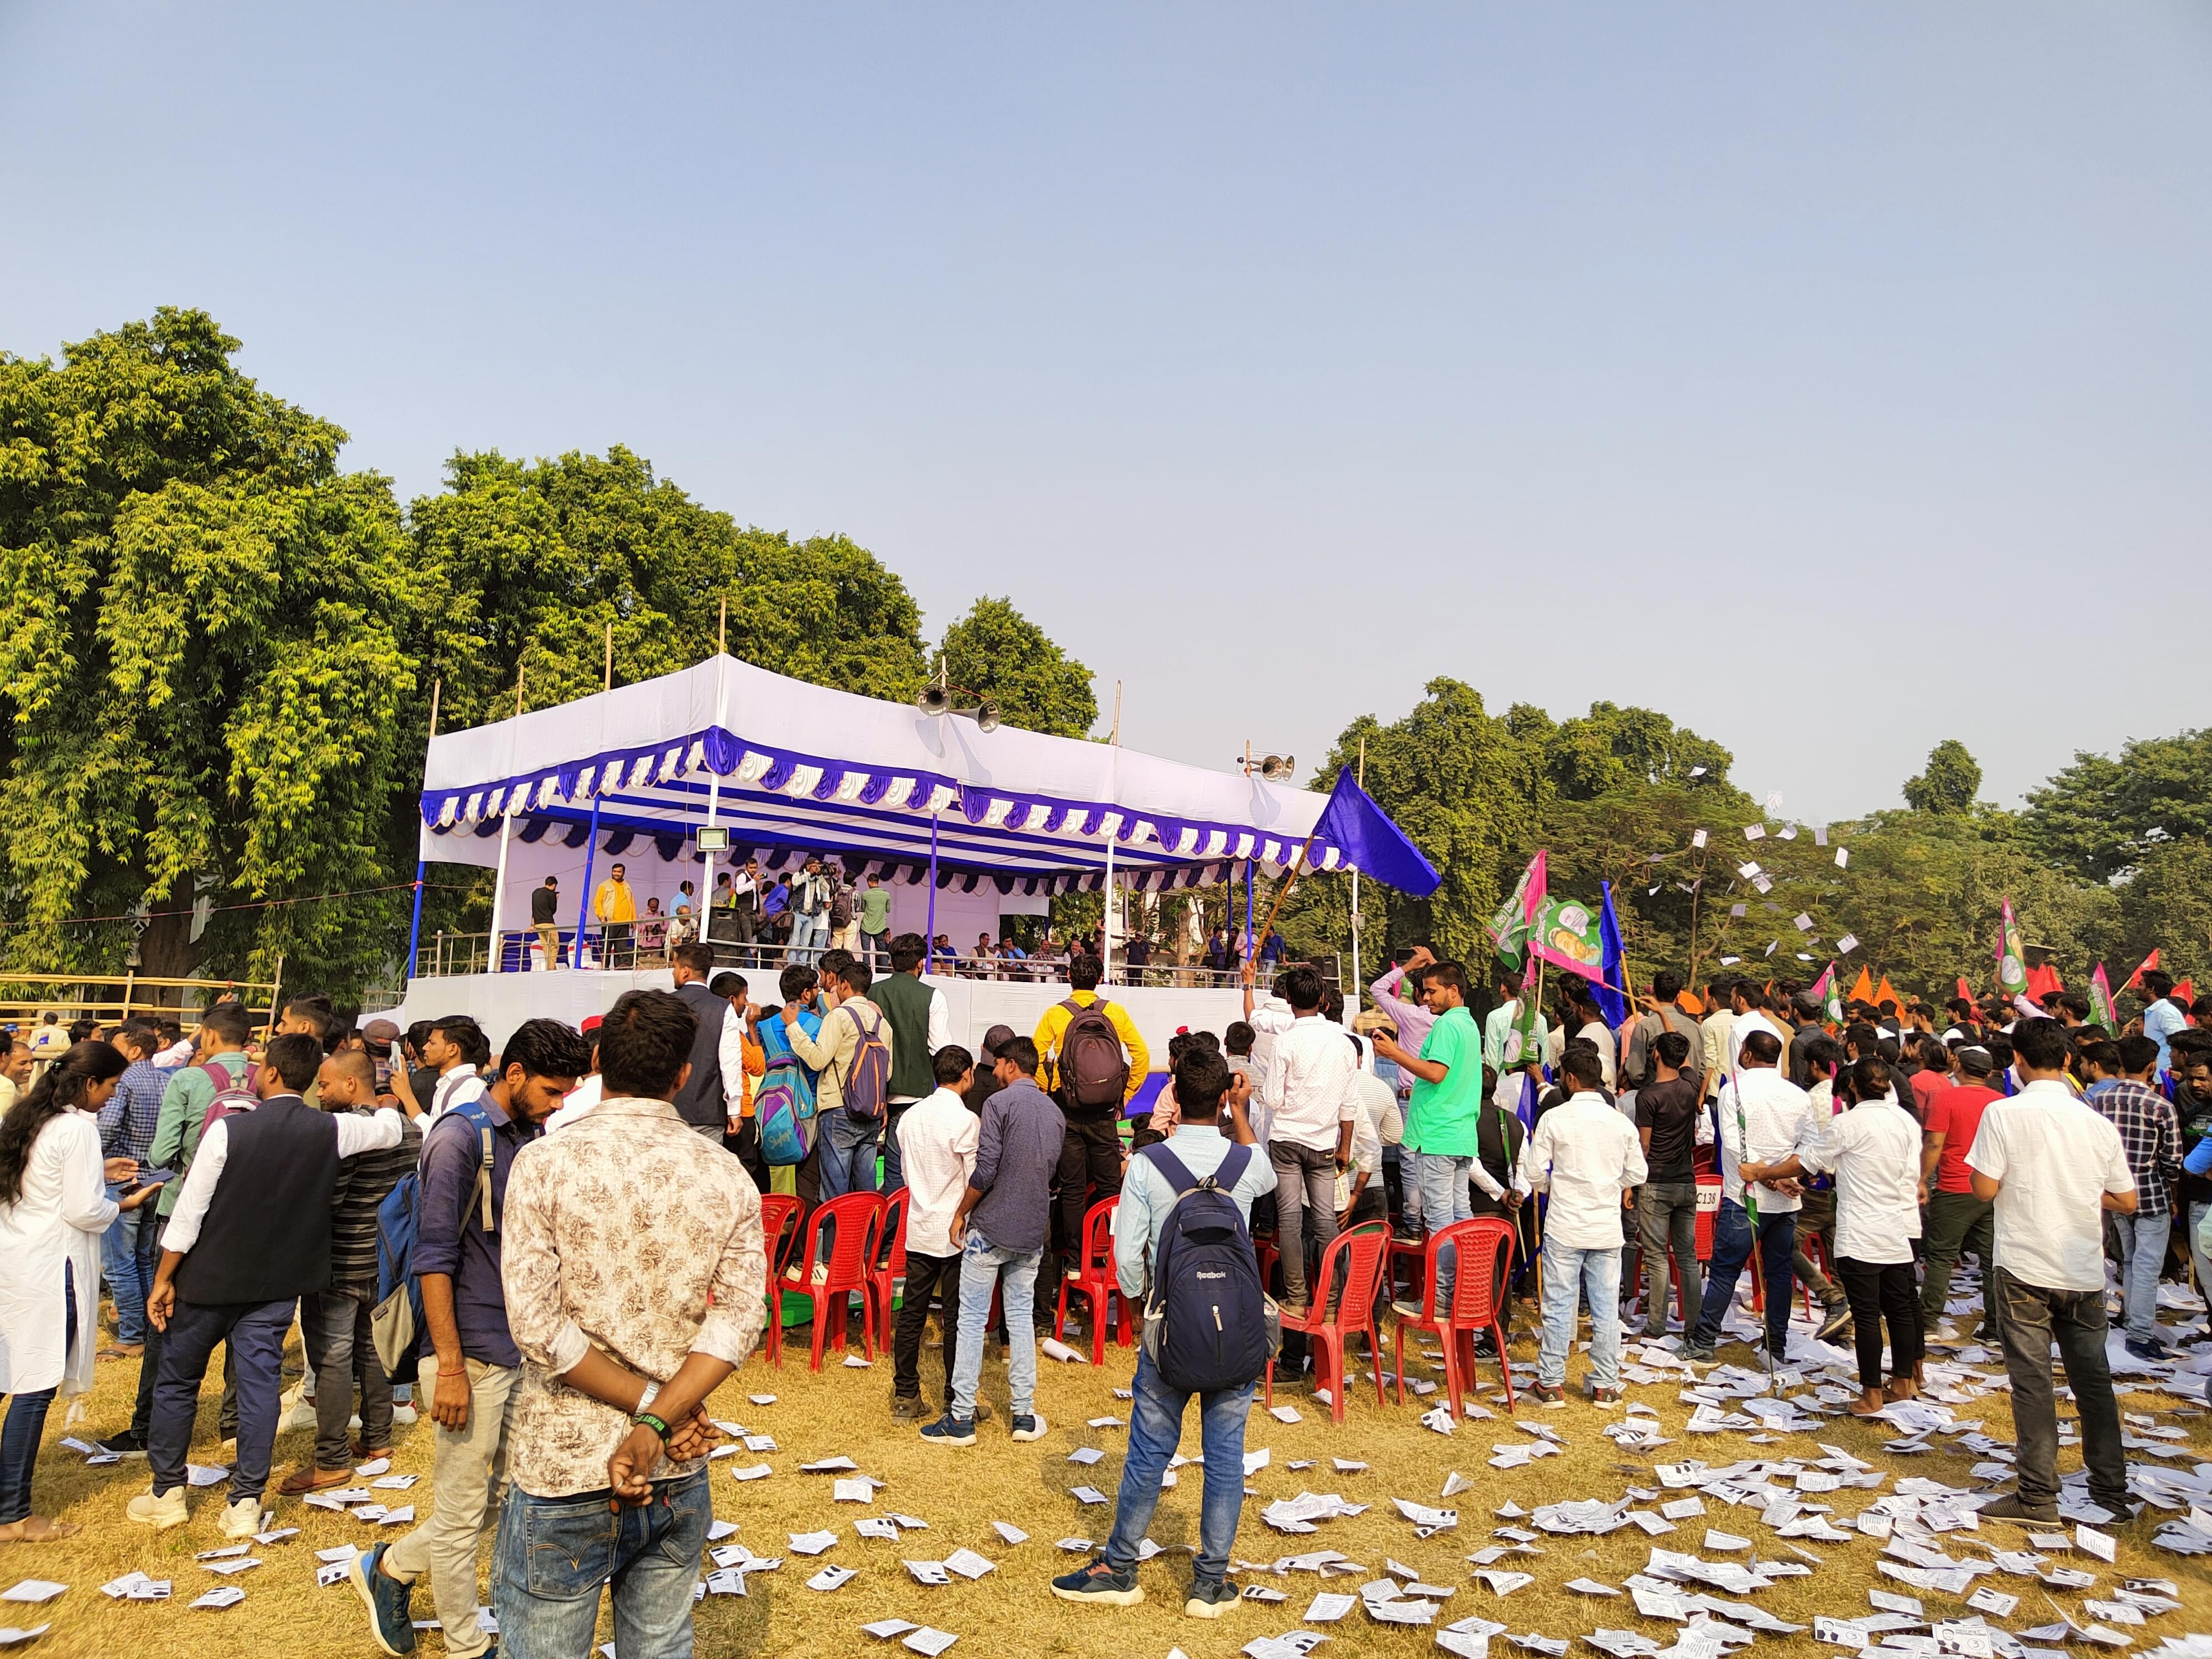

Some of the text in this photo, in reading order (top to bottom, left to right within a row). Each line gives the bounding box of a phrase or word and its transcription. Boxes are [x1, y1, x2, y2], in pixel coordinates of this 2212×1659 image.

[1696, 1192, 1717, 1204] C138
[1196, 1271, 1226, 1280] Reebok
[1972, 1640, 1979, 1648] 3
